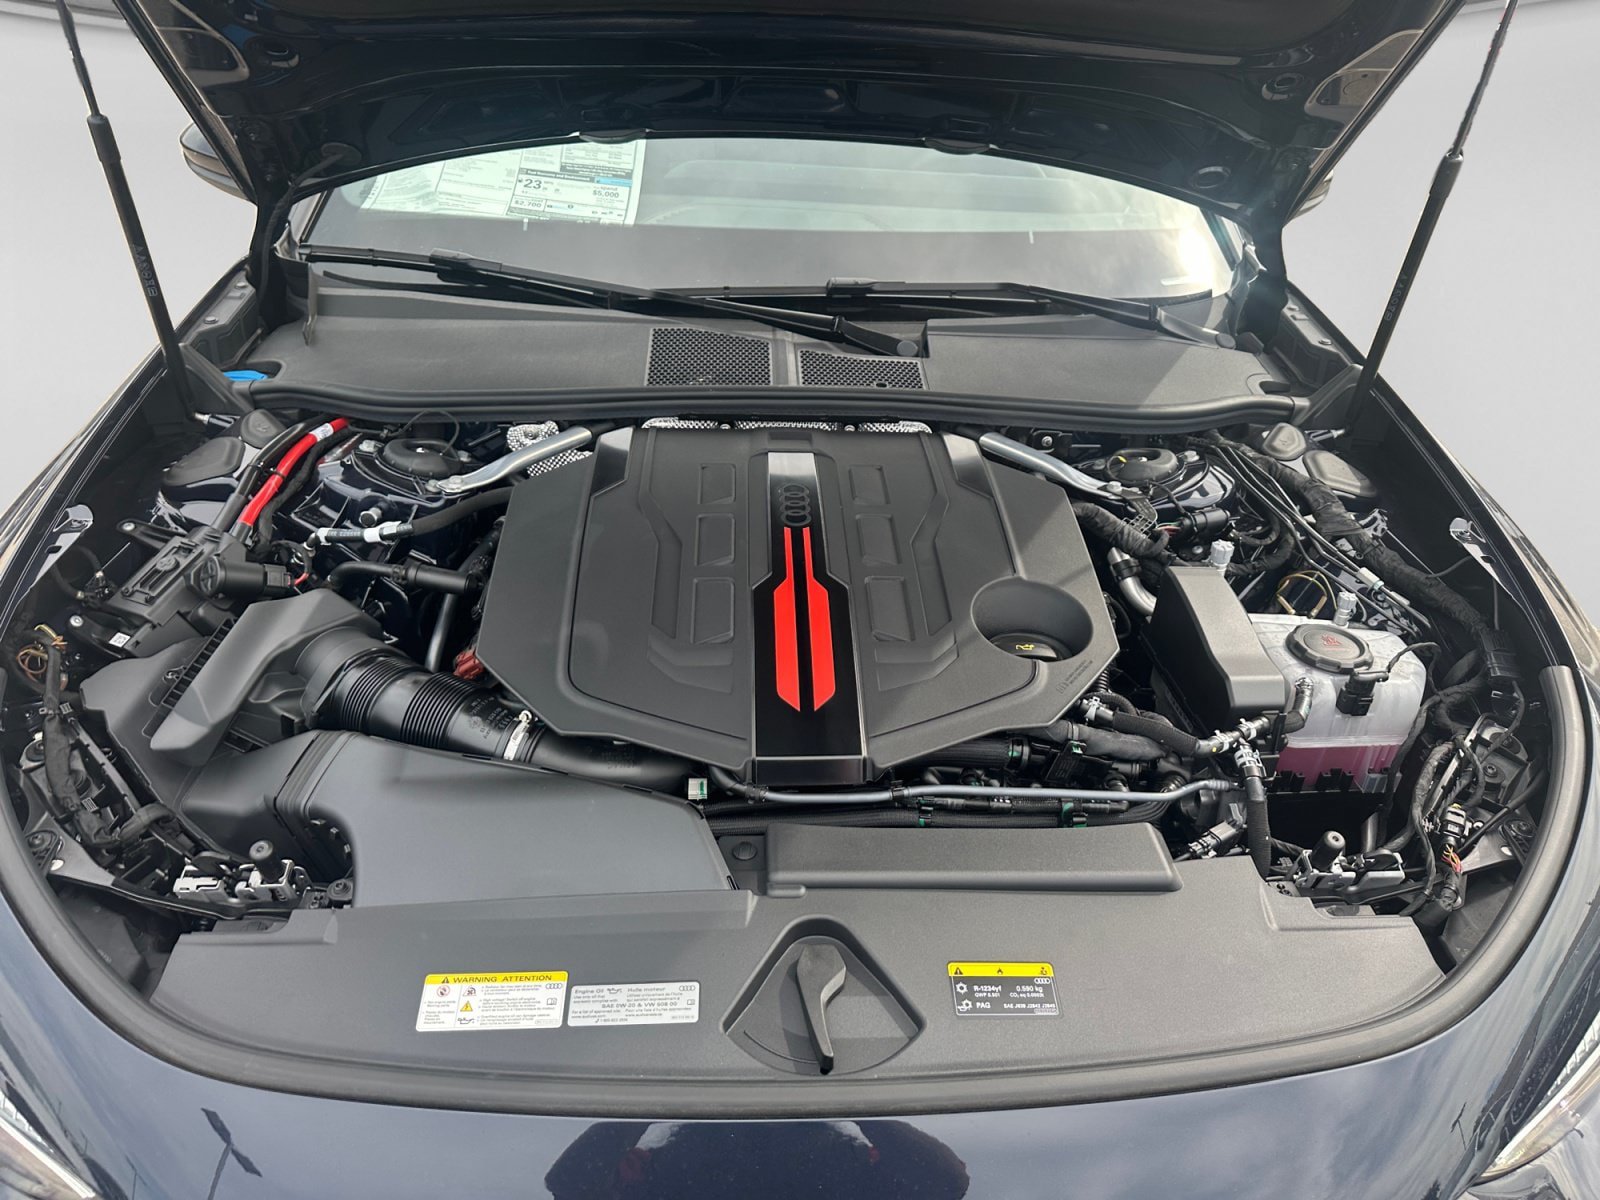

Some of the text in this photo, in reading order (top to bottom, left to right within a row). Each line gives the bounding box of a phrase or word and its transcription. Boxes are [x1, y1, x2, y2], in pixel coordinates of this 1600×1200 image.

[524, 178, 542, 189] 23
[592, 190, 619, 198] $5,000
[514, 200, 542, 208] $2,700
